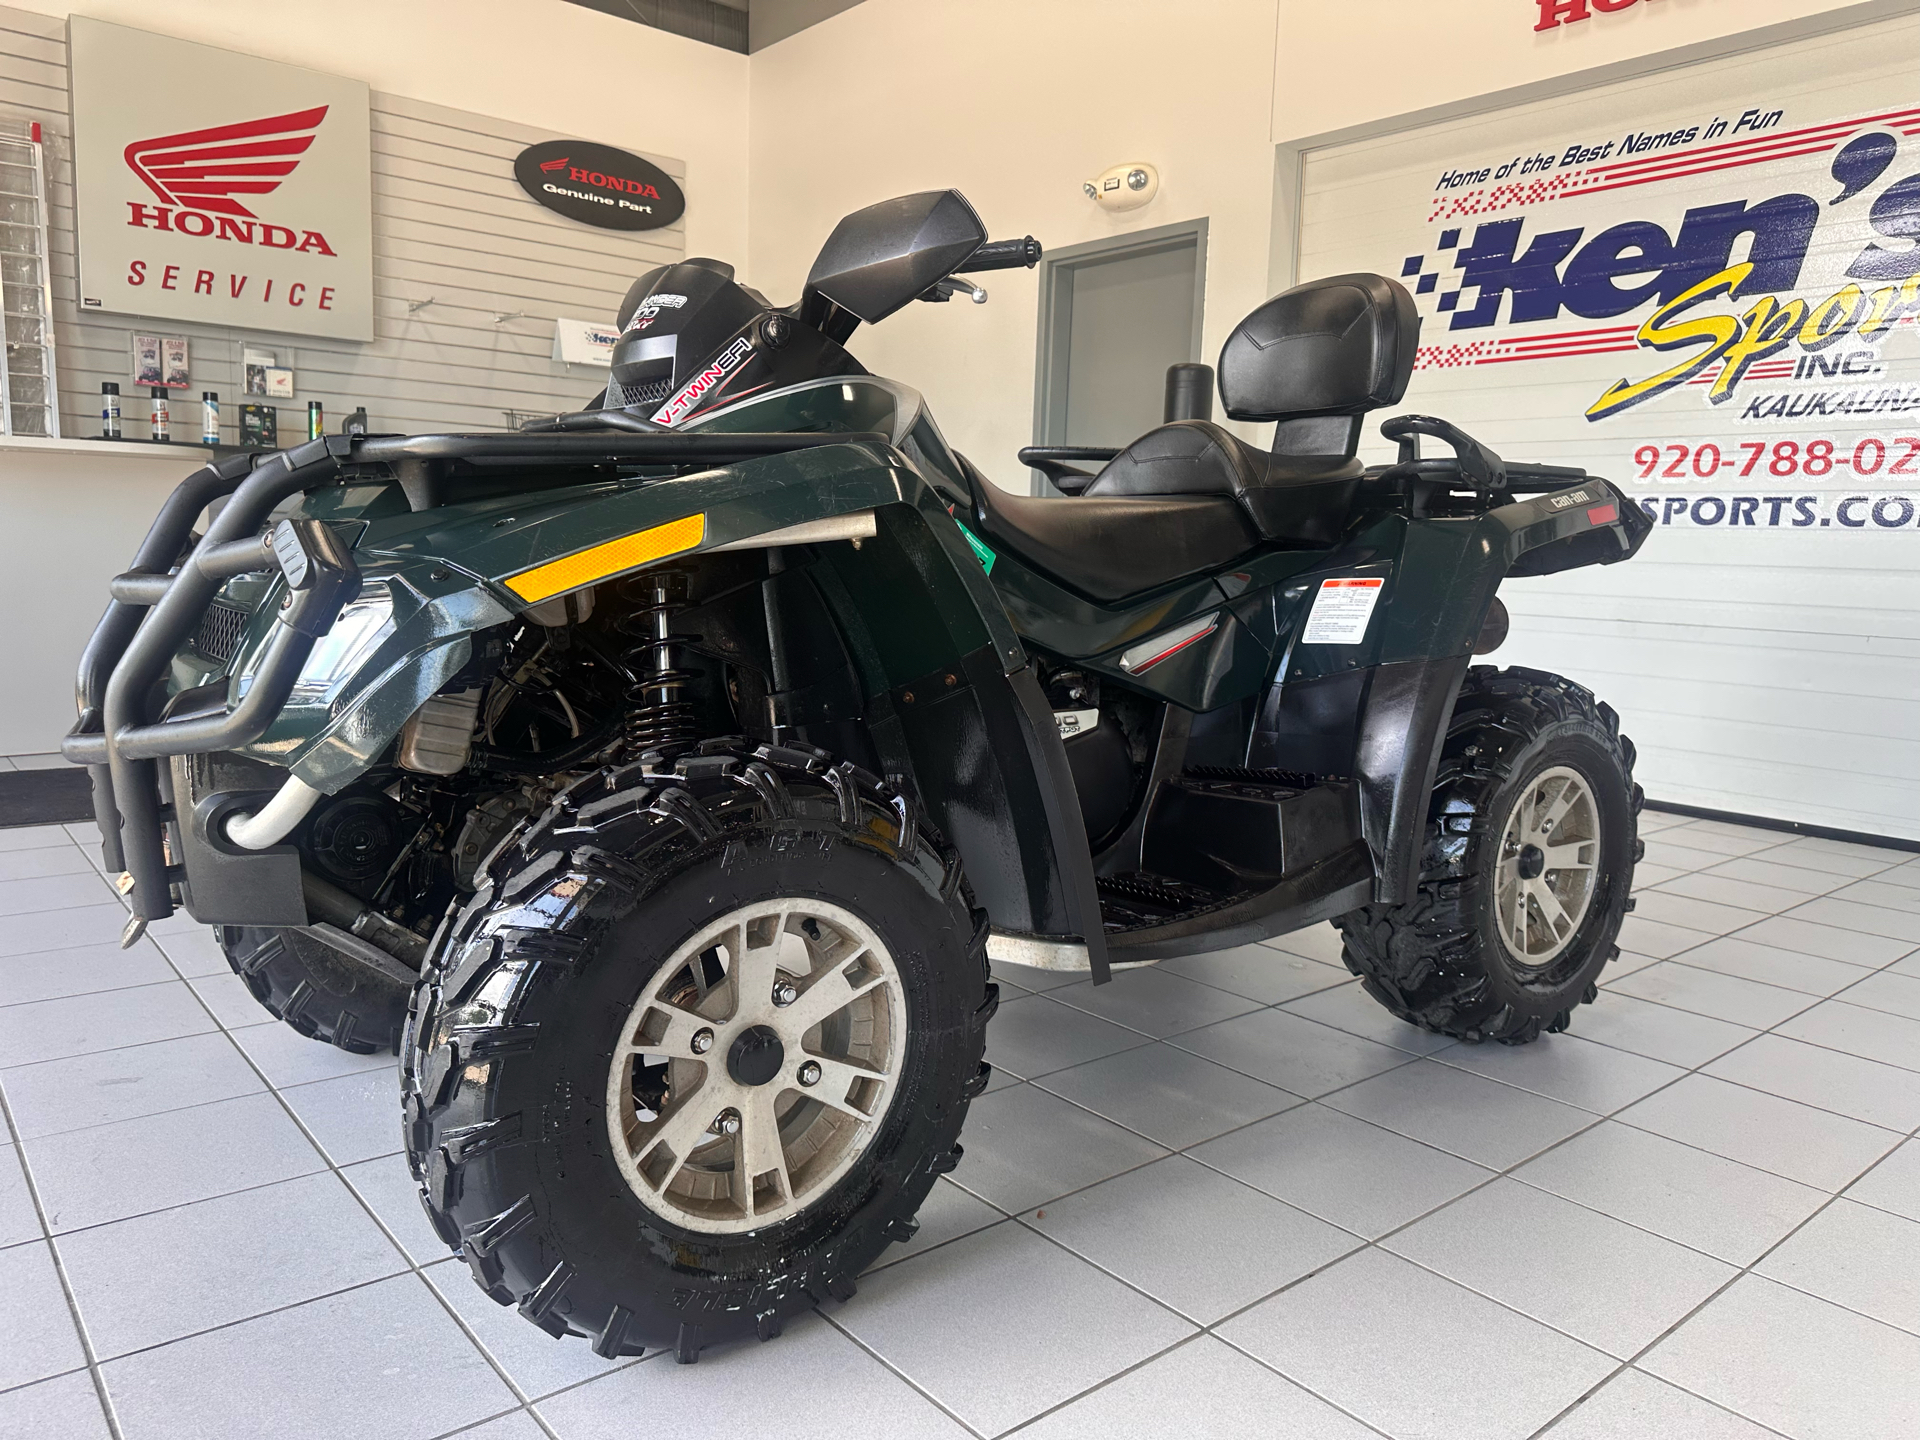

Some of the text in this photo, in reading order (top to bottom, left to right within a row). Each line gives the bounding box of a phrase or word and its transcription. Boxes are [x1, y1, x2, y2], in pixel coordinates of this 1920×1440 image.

[1435, 108, 1784, 191] Home of the Best Names in Fun
[542, 183, 652, 214] Genuine Part
[569, 166, 661, 200] HONDA
[126, 201, 338, 257] HONDA
[127, 260, 336, 311] SERVICE
[1585, 261, 1920, 423] Spor
[1793, 350, 1881, 381] INC.
[1550, 490, 1590, 508] can-am
[1641, 495, 1920, 528] SPORTS.CO
